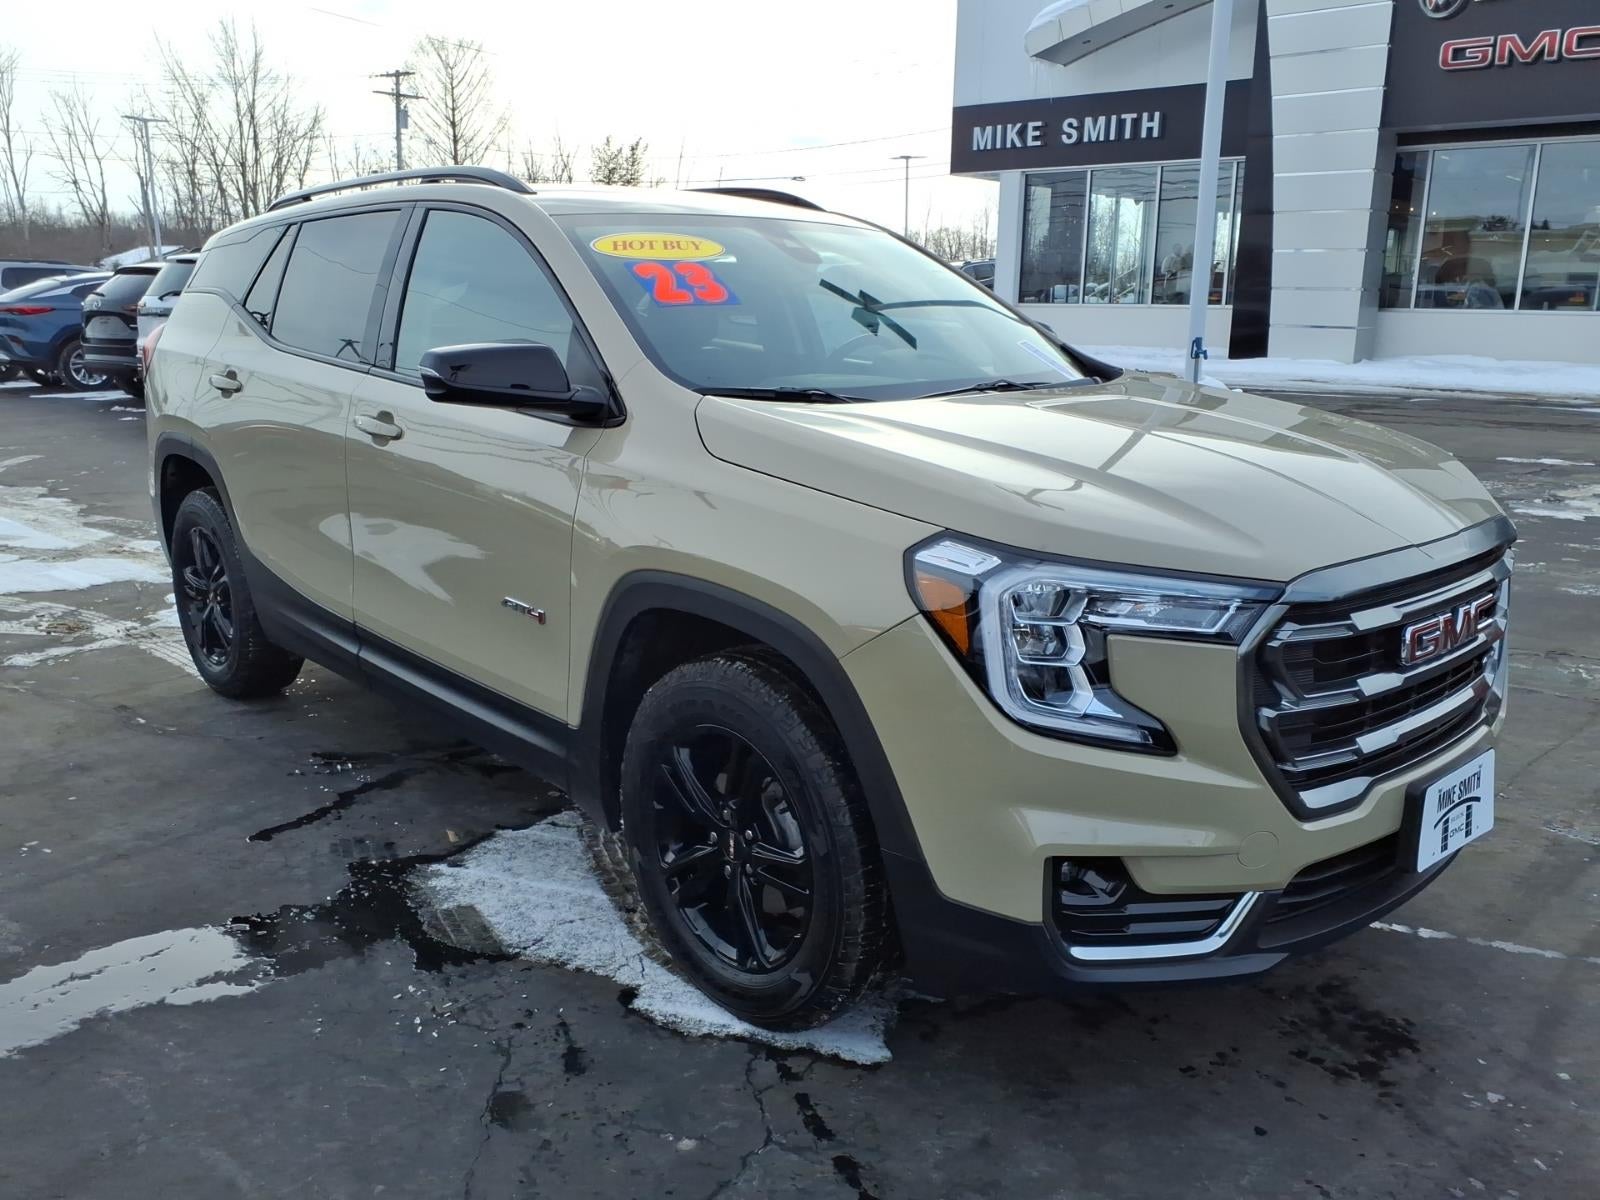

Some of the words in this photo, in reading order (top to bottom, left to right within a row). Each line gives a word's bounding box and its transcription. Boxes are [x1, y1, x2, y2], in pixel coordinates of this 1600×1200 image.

[1439, 25, 1600, 70] GMC
[972, 121, 1043, 150] MIKE
[1061, 111, 1161, 145] SMITH
[612, 239, 659, 251] HOT
[663, 240, 703, 251] BUY
[633, 262, 729, 304] 23
[1403, 593, 1497, 665] GMC
[1437, 785, 1457, 814] MIKE
[1458, 769, 1482, 800] SMITH
